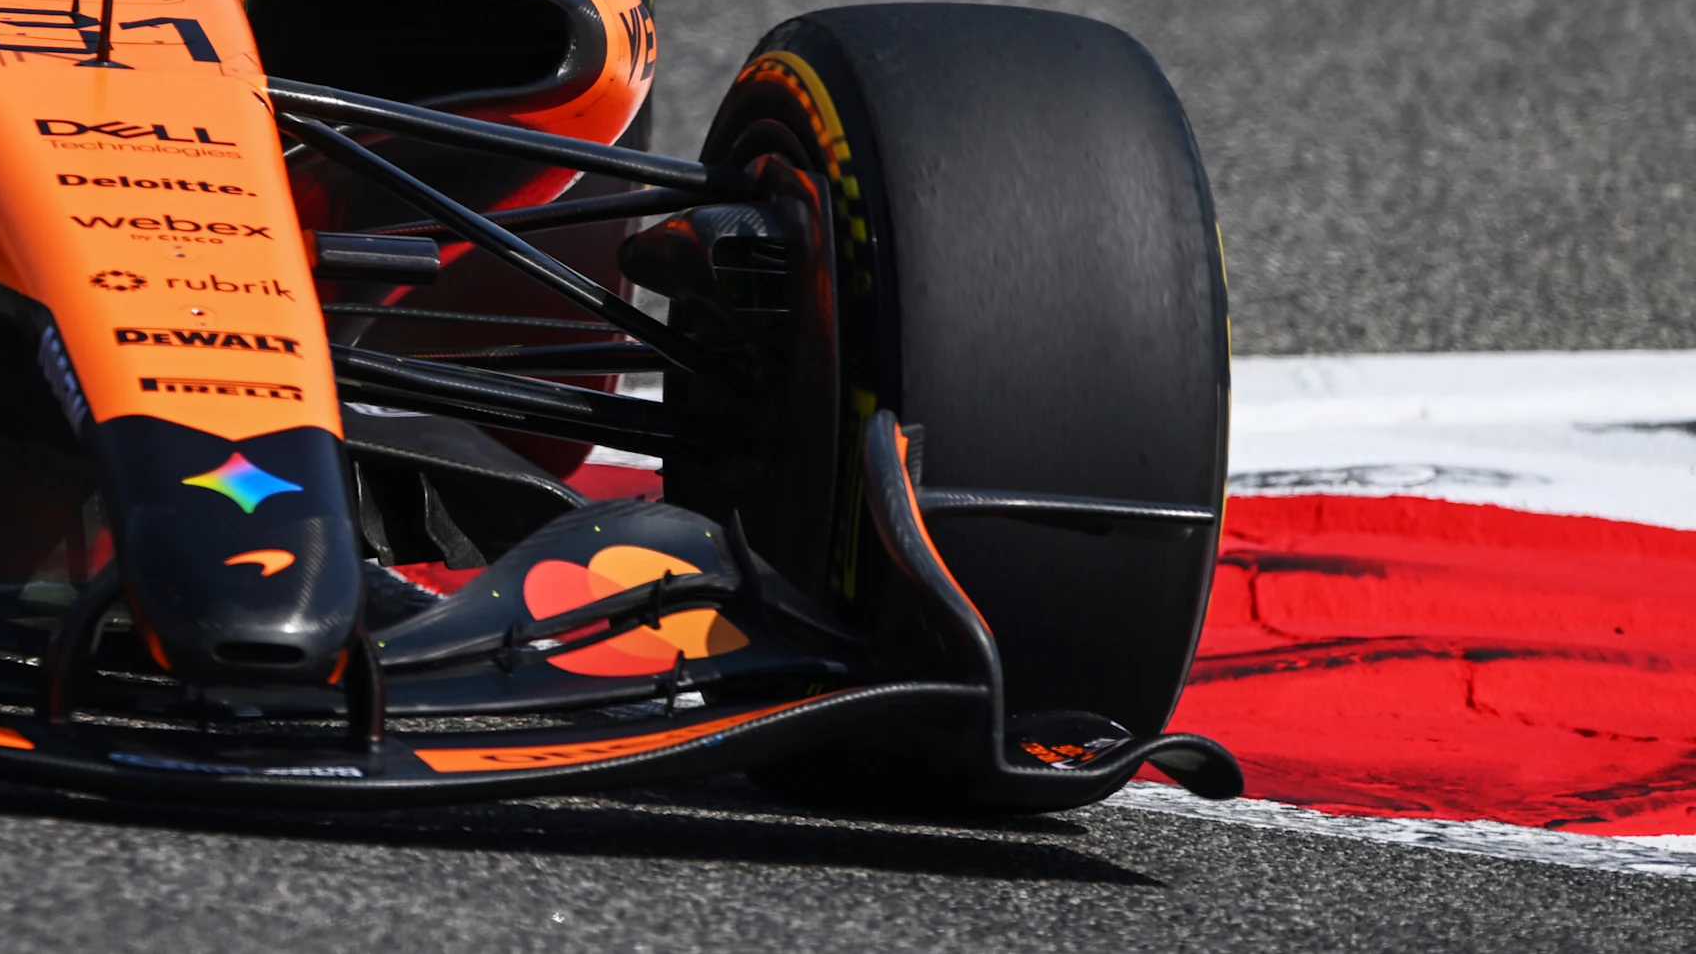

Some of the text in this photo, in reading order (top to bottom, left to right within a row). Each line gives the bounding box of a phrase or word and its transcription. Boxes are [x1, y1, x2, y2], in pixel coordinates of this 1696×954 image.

[34, 118, 237, 146] DELL
[42, 139, 242, 159] Technologies
[56, 174, 257, 196] Deloitte.
[70, 214, 274, 240] webex
[165, 274, 295, 302] rubrik
[139, 377, 303, 402] PIRELLI
